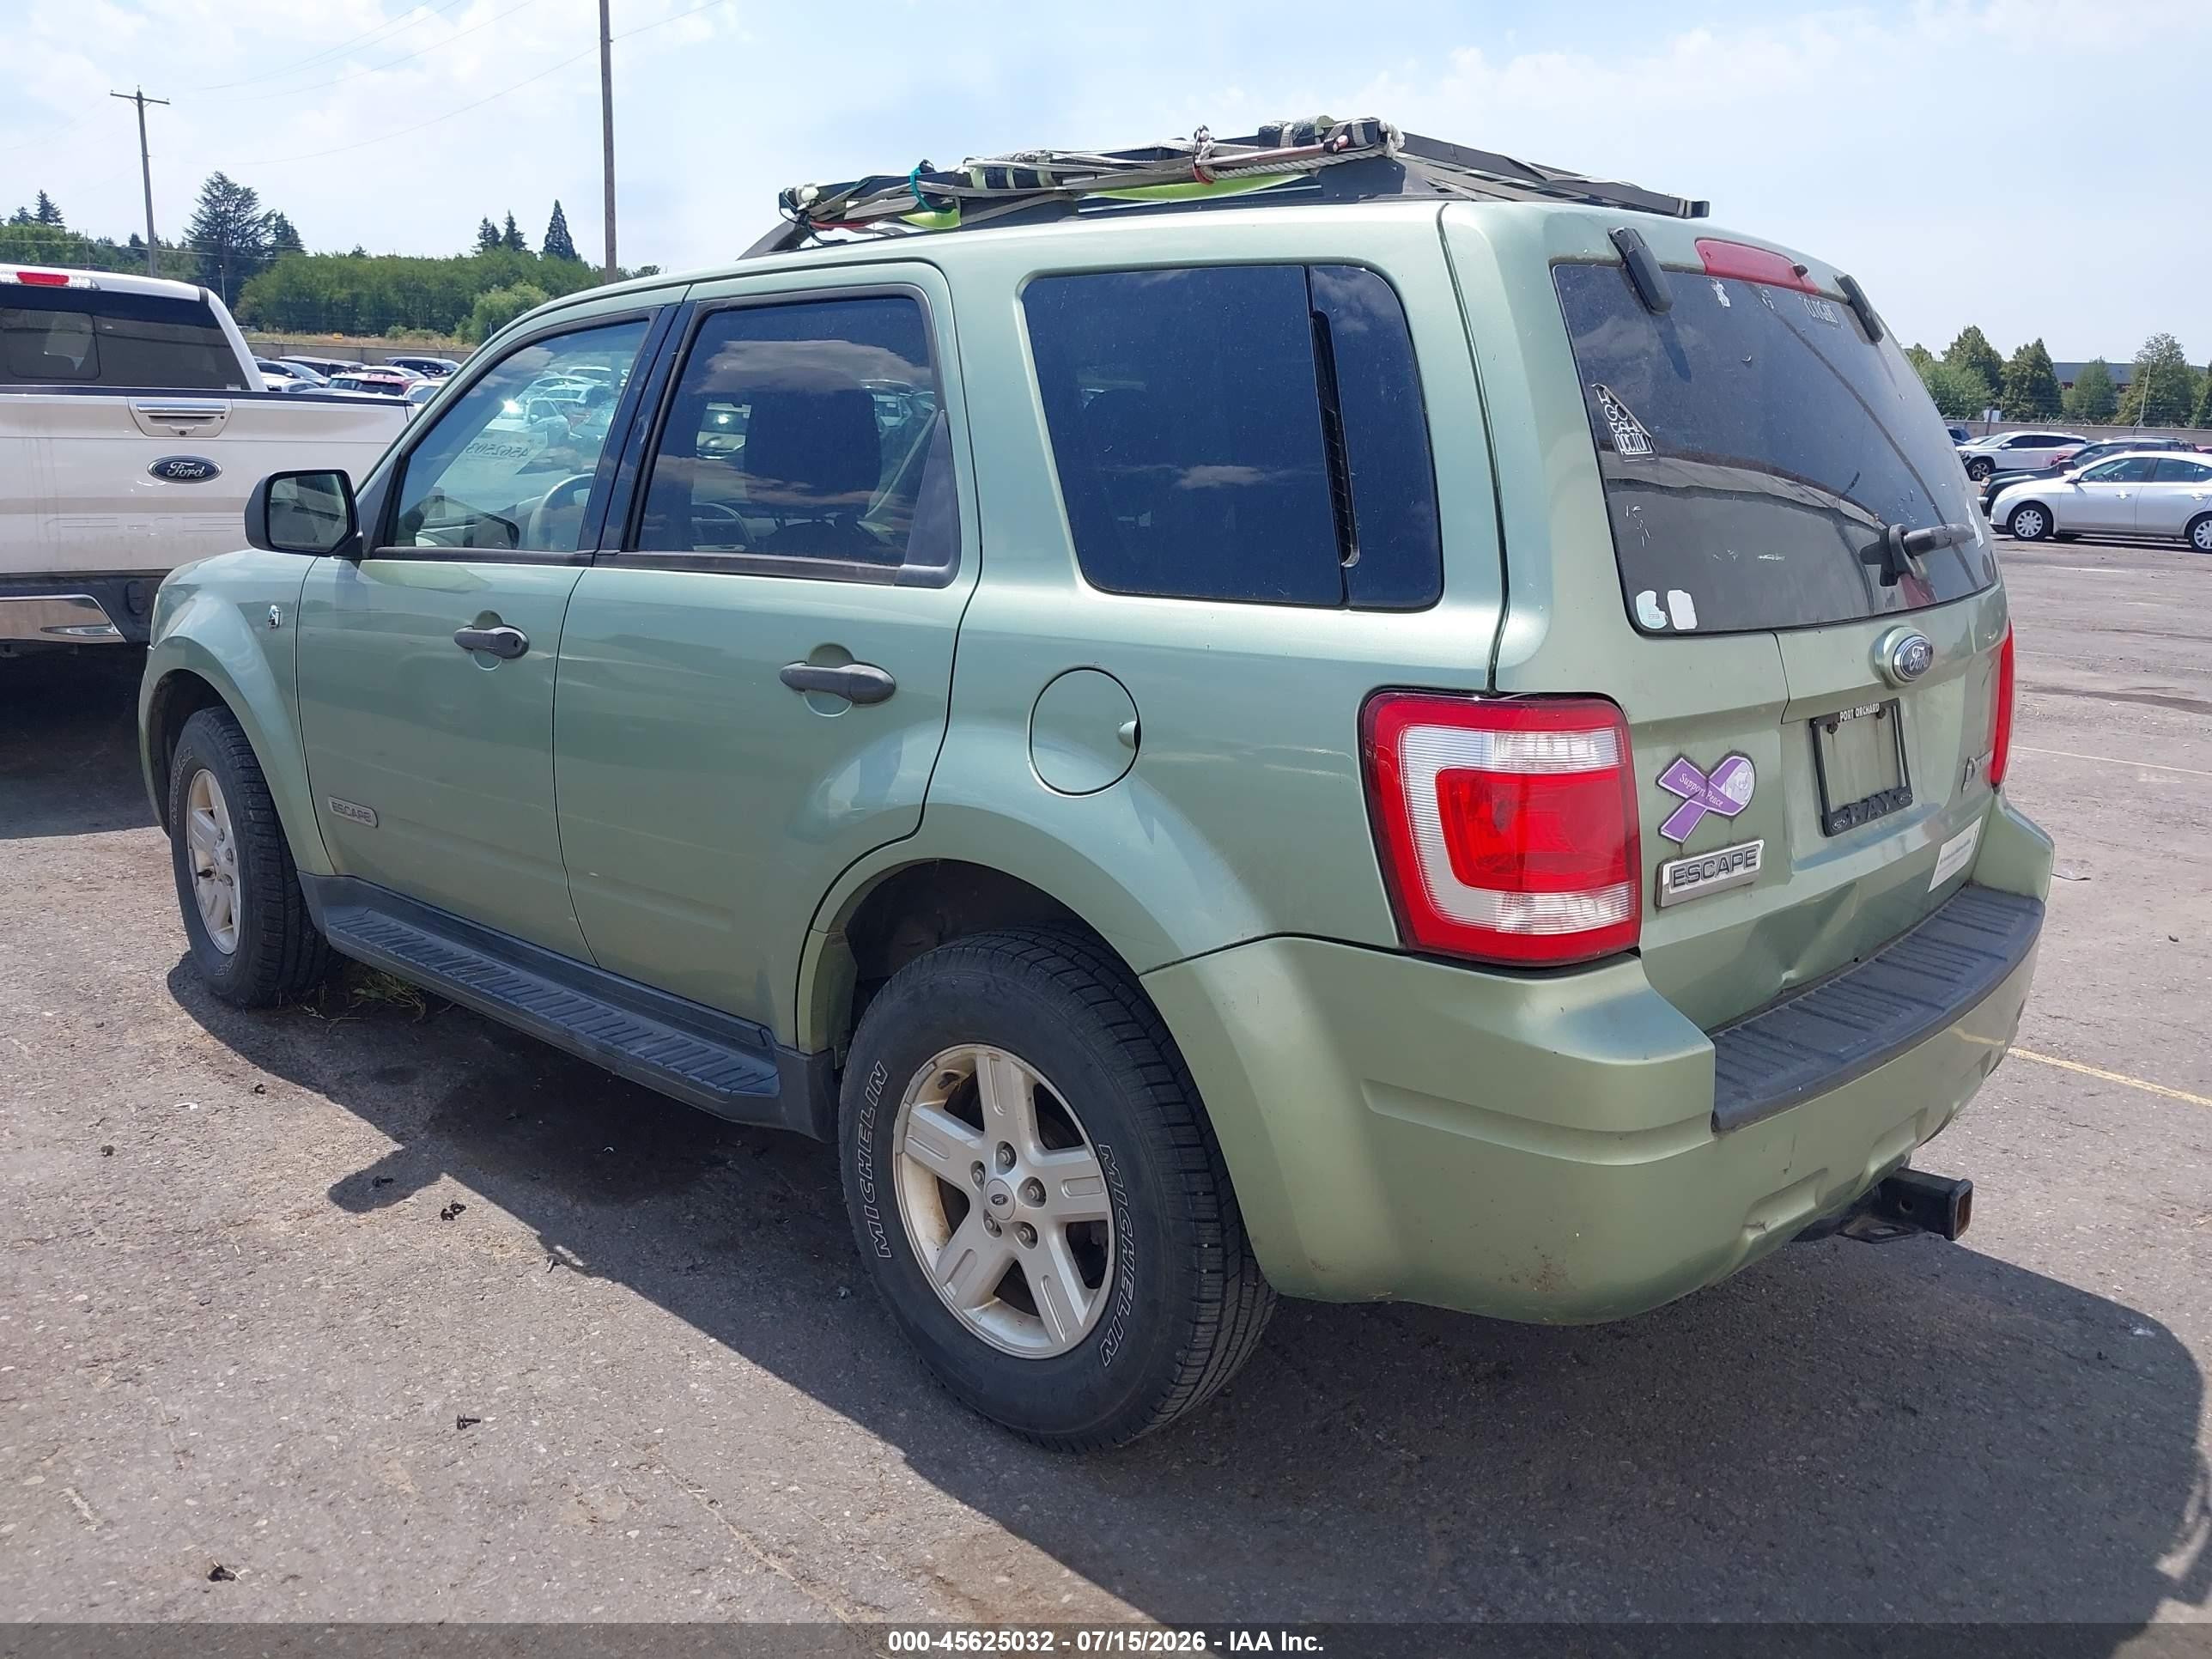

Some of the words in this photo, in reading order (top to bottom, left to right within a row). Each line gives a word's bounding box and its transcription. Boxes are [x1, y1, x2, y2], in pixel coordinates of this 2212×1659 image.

[167, 461, 205, 477] Ford
[1839, 708, 1854, 723] PORT
[1856, 702, 1880, 718] ORCHARD
[1679, 773, 1706, 797] Support
[1705, 789, 1724, 808] Peace
[331, 801, 372, 823] ESCAPE
[1673, 848, 1758, 888] ESCAPE
[858, 1060, 893, 1258] MICHELIN
[1098, 1143, 1135, 1368] MICHELIN
